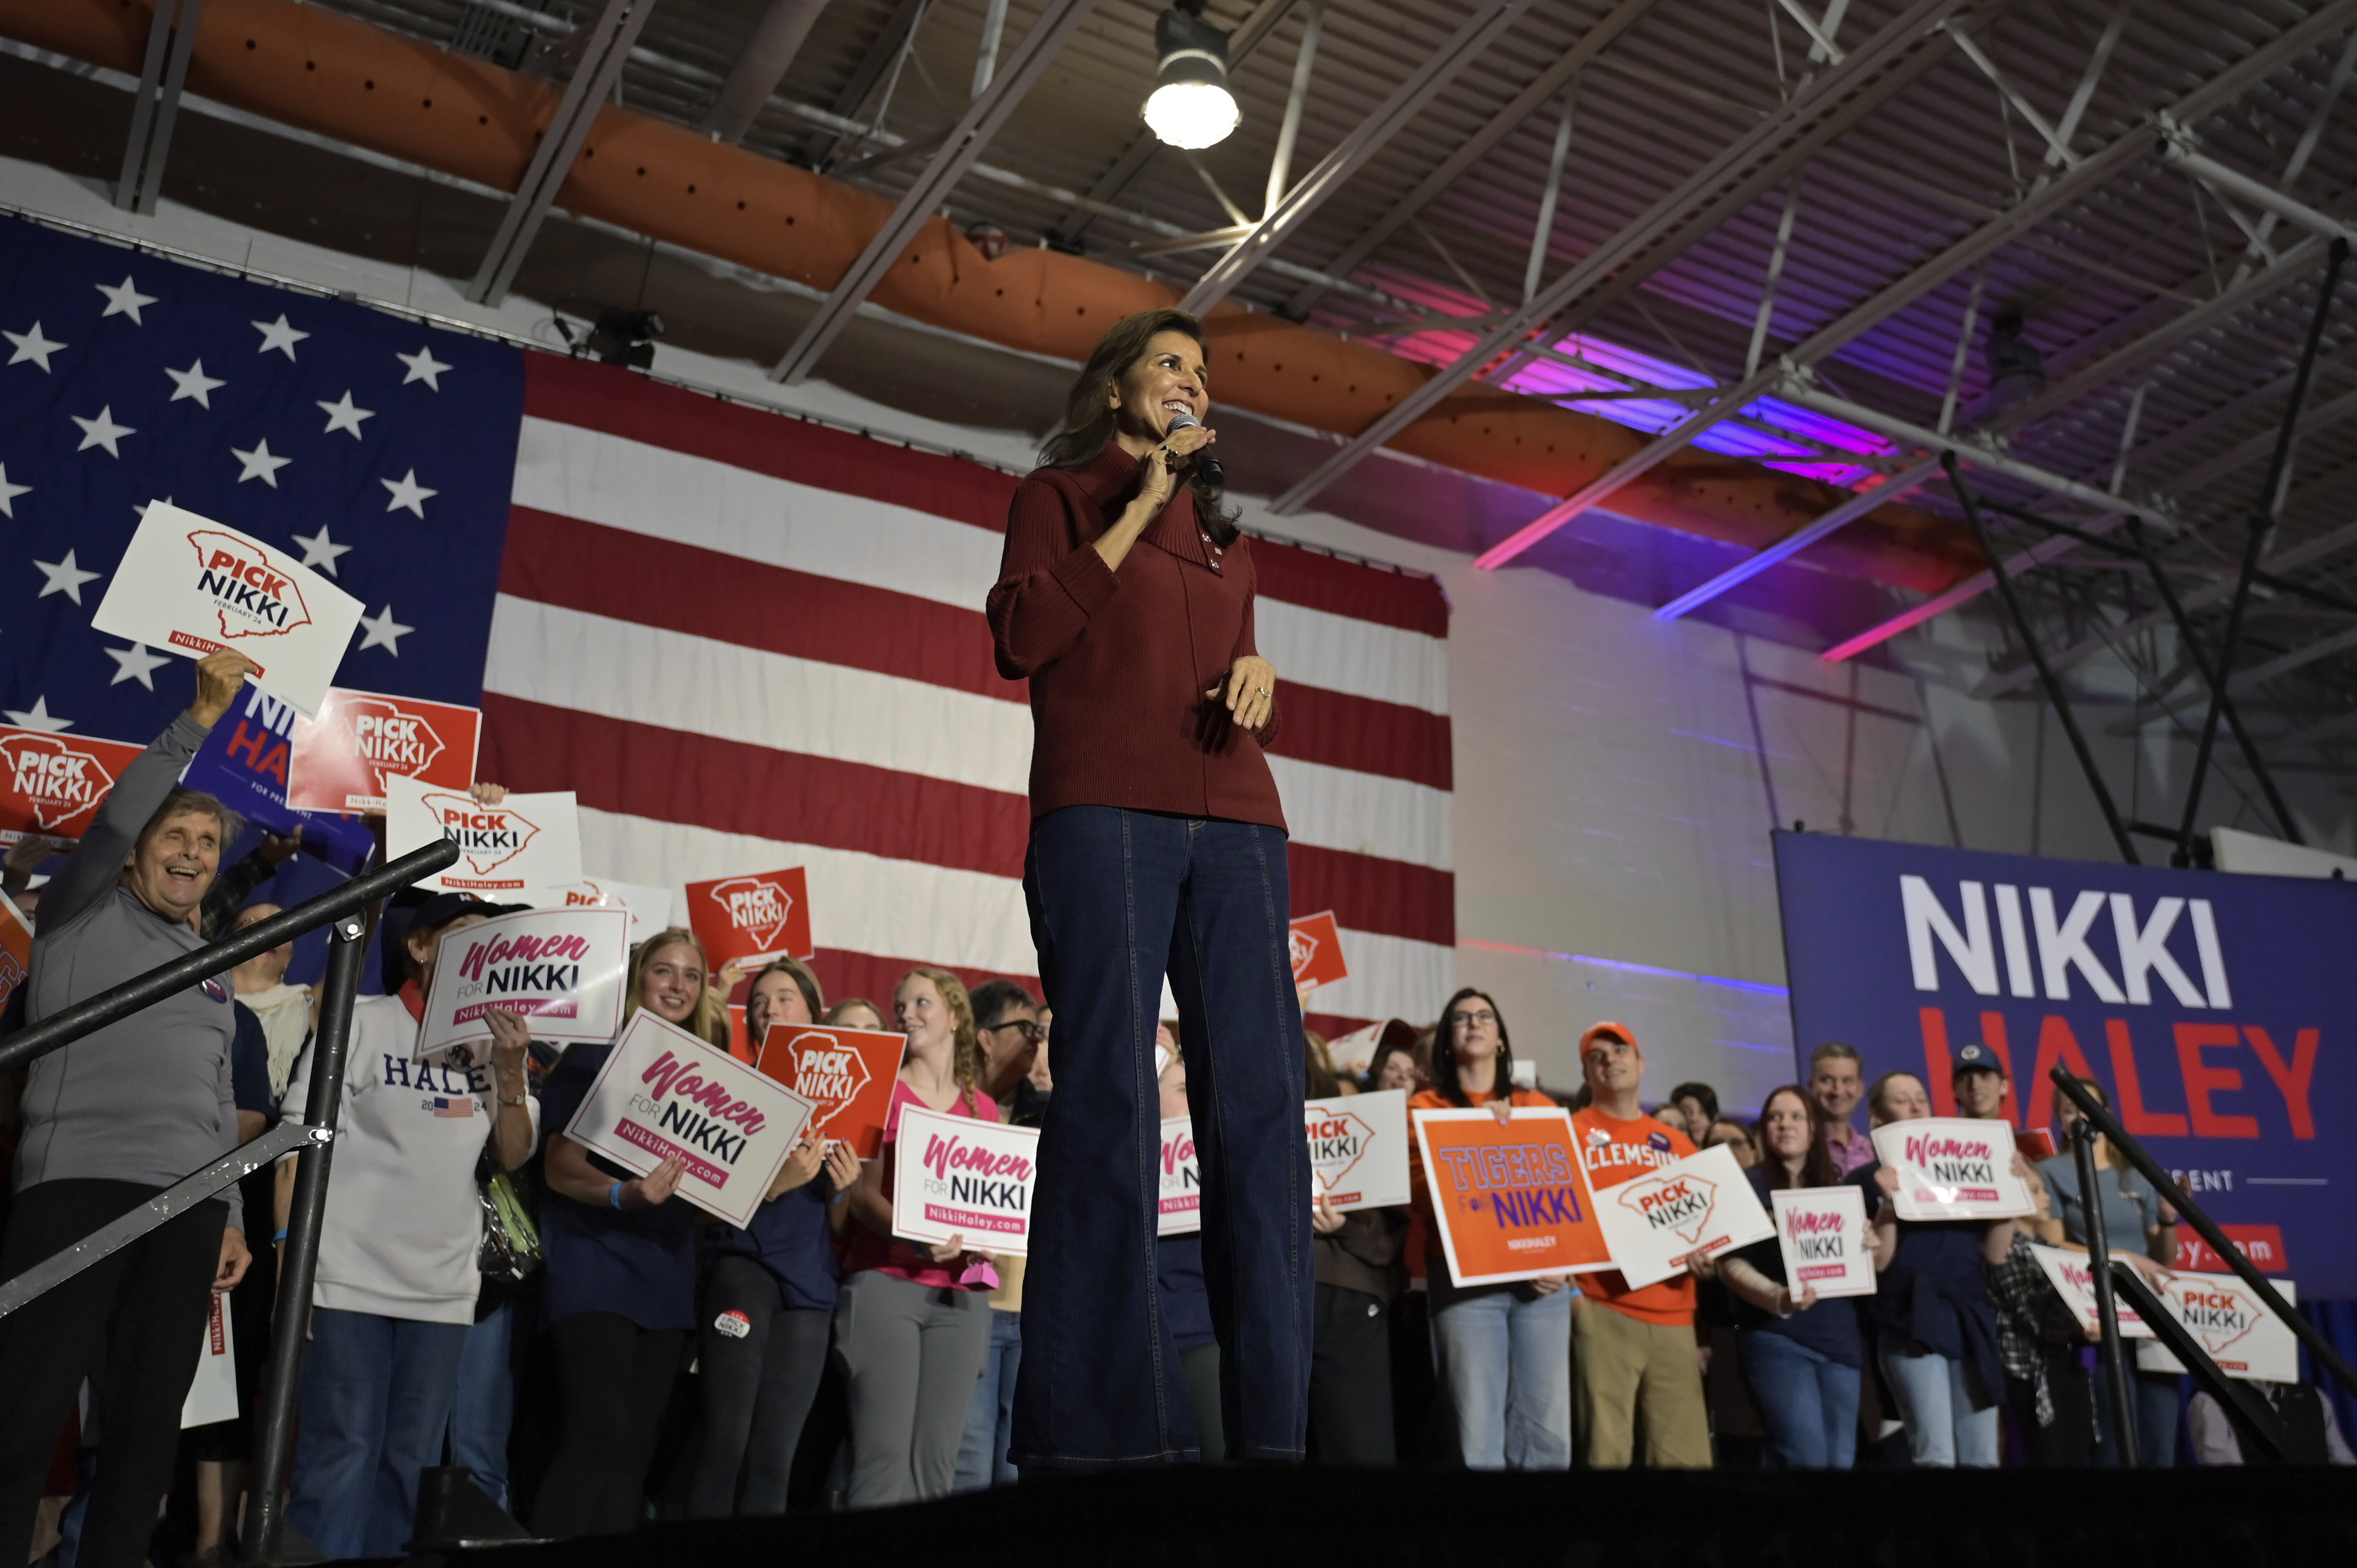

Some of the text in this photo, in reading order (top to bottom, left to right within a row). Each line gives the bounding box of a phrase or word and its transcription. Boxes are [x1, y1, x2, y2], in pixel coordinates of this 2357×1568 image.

[208, 549, 288, 601] PICK
[197, 569, 289, 628] NIKKI
[214, 599, 262, 625] FEBRUARY 24
[356, 715, 418, 742] PICK
[18, 750, 88, 780] PICK
[354, 735, 425, 765] NIKKI
[369, 760, 400, 770] FEBRUARY
[13, 770, 93, 803] NIKKI
[29, 796, 62, 807] FEBRUARY
[251, 781, 268, 796] FOR
[444, 808, 508, 830] PICK
[444, 826, 518, 848] NIKKI
[445, 879, 521, 889] NikkiHaley.com
[729, 887, 777, 910] PICK
[732, 903, 783, 928] NIKKI
[459, 932, 590, 981] Women
[1899, 874, 2233, 1010] NIKKI
[457, 965, 579, 999] FOR NIKKI
[384, 1053, 493, 1095] HALE
[800, 1049, 853, 1075] PICK
[1919, 1007, 2320, 1140] HALEY
[642, 1051, 766, 1135] Women
[794, 1072, 853, 1099] NIKKI
[422, 1100, 433, 1111] 20
[629, 1093, 747, 1166] FOR NIKKI
[923, 1133, 1034, 1181] Women
[1308, 1137, 1357, 1160] IKKI
[1905, 1132, 1992, 1168] Women
[1440, 1143, 1573, 1191] TIGERS
[1933, 1162, 1993, 1183] NIKKI
[924, 1174, 1025, 1210] FOR NIKKI
[1639, 1180, 1691, 1212] PICK
[929, 1206, 1021, 1231] NikkiHaley.com
[1491, 1187, 1583, 1229] NIKKI
[1648, 1191, 1708, 1229] NIKKI
[1785, 1206, 1846, 1246] Women
[1799, 1235, 1843, 1260] NIKKI
[2184, 1290, 2235, 1310] PICK
[2183, 1308, 2245, 1329] NIKKI
